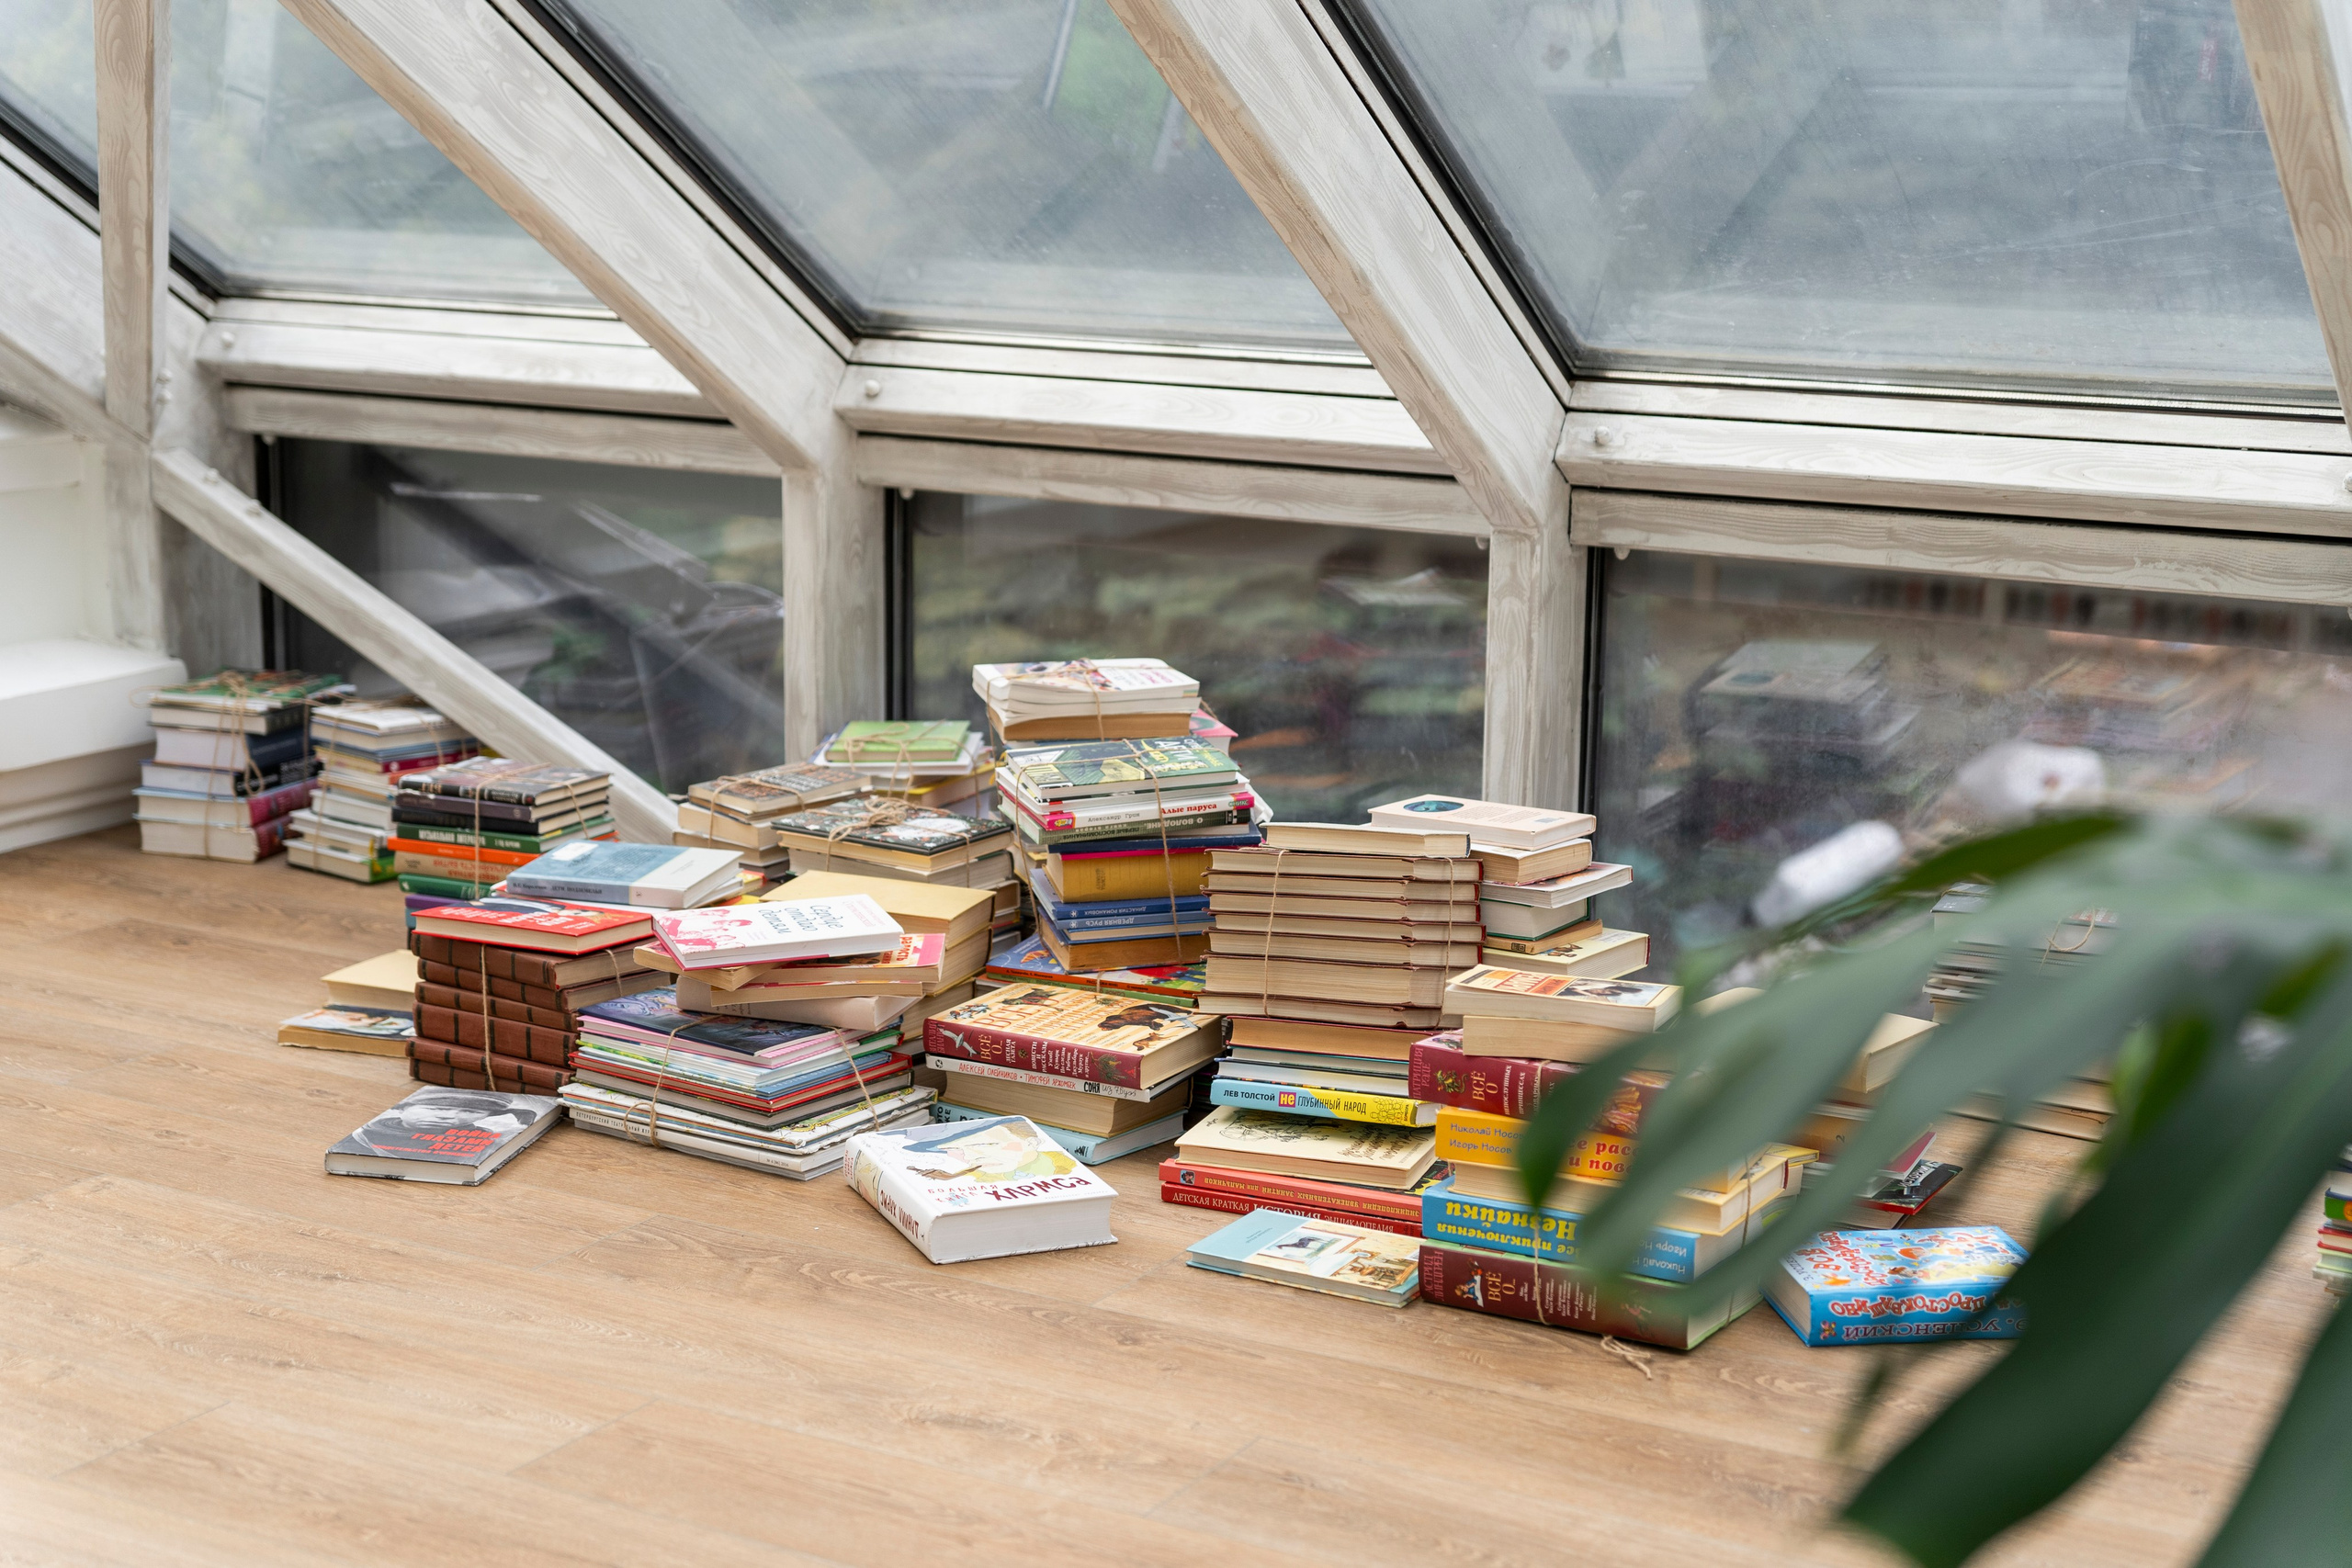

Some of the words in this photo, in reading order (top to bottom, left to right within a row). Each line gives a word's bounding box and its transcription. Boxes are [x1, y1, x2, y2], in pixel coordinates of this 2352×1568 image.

[1160, 807, 1185, 816] Алые
[1186, 802, 1217, 815] паруса
[1087, 814, 1123, 824] Александр
[1125, 812, 1141, 820] Грин
[1062, 829, 1113, 840] ВОСПОМИНАНИЯ
[1114, 826, 1140, 835] ПЕРВЫЕ
[810, 904, 843, 930] Сердце
[1084, 908, 1118, 916] РОМАНОВЫХ
[1118, 906, 1147, 914] ДИНАСТИЯ
[785, 907, 819, 931] отдаю
[1104, 917, 1135, 926] ДРЕВНЯЯ
[979, 1034, 992, 1062] ВСЁ
[959, 1062, 986, 1077] АЛЕКСЕЙ
[988, 1066, 1017, 1081] ОЛЕЙНИКОВ
[1024, 1073, 1051, 1087] ТИМОФЕЙ
[1413, 1046, 1424, 1100] ПАТРИЦИЯ
[1083, 1081, 1101, 1093] СОНЯ
[1472, 1070, 1486, 1101] ВСЁ
[1487, 1082, 1498, 1095] О
[1504, 1065, 1512, 1116] НЕПОСЛУШНЫХ
[1224, 1089, 1238, 1098] ЛЕВ
[1240, 1090, 1275, 1101] ТОЛСТОЙ
[1279, 1094, 1295, 1106] не
[1297, 1096, 1341, 1110] ГЛУБИННЫЙ
[1343, 1101, 1367, 1114] НАРОД
[576, 1111, 610, 1126] ПЕТЕРБУРГСКИЙ
[446, 1128, 503, 1140] ВОЙНА
[1450, 1122, 1491, 1136] Николай
[412, 1133, 495, 1145] ГЛАЗАМИ
[428, 1142, 486, 1153] ДЕТЕЙ
[1449, 1139, 1478, 1151] Игорь
[1482, 1143, 1512, 1155] Носов
[1568, 1156, 1581, 1168] и
[927, 1184, 998, 1194] БОЛЬШАЯ
[1204, 1178, 1245, 1190] МАЛЬЧИКОВ
[1247, 1183, 1260, 1191] для
[1261, 1187, 1295, 1199] ЗАНЯТИЙ
[1297, 1191, 1359, 1208] УВЛЕКАТЕЛЬНЫХ
[1172, 1191, 1210, 1206] ДЕТСКАЯ
[1212, 1198, 1250, 1213] КРАТКАЯ
[1362, 1203, 1420, 1217] ЭНЦИКЛОПЕДИЯ
[1445, 1201, 1577, 1242] Незнайки
[1437, 1223, 1553, 1252] приключения
[1655, 1242, 1688, 1258] Игорь
[1423, 1253, 1434, 1293] АСТРИД
[1643, 1257, 1686, 1275] Николай
[1432, 1250, 1444, 1302] ЛИНДГРЕН
[1487, 1272, 1502, 1303] ВСЁ
[1829, 1291, 1987, 1318] ПРОСТОКВАШИНО
[1842, 1317, 2001, 1340] УСПЕНСКИЙ
